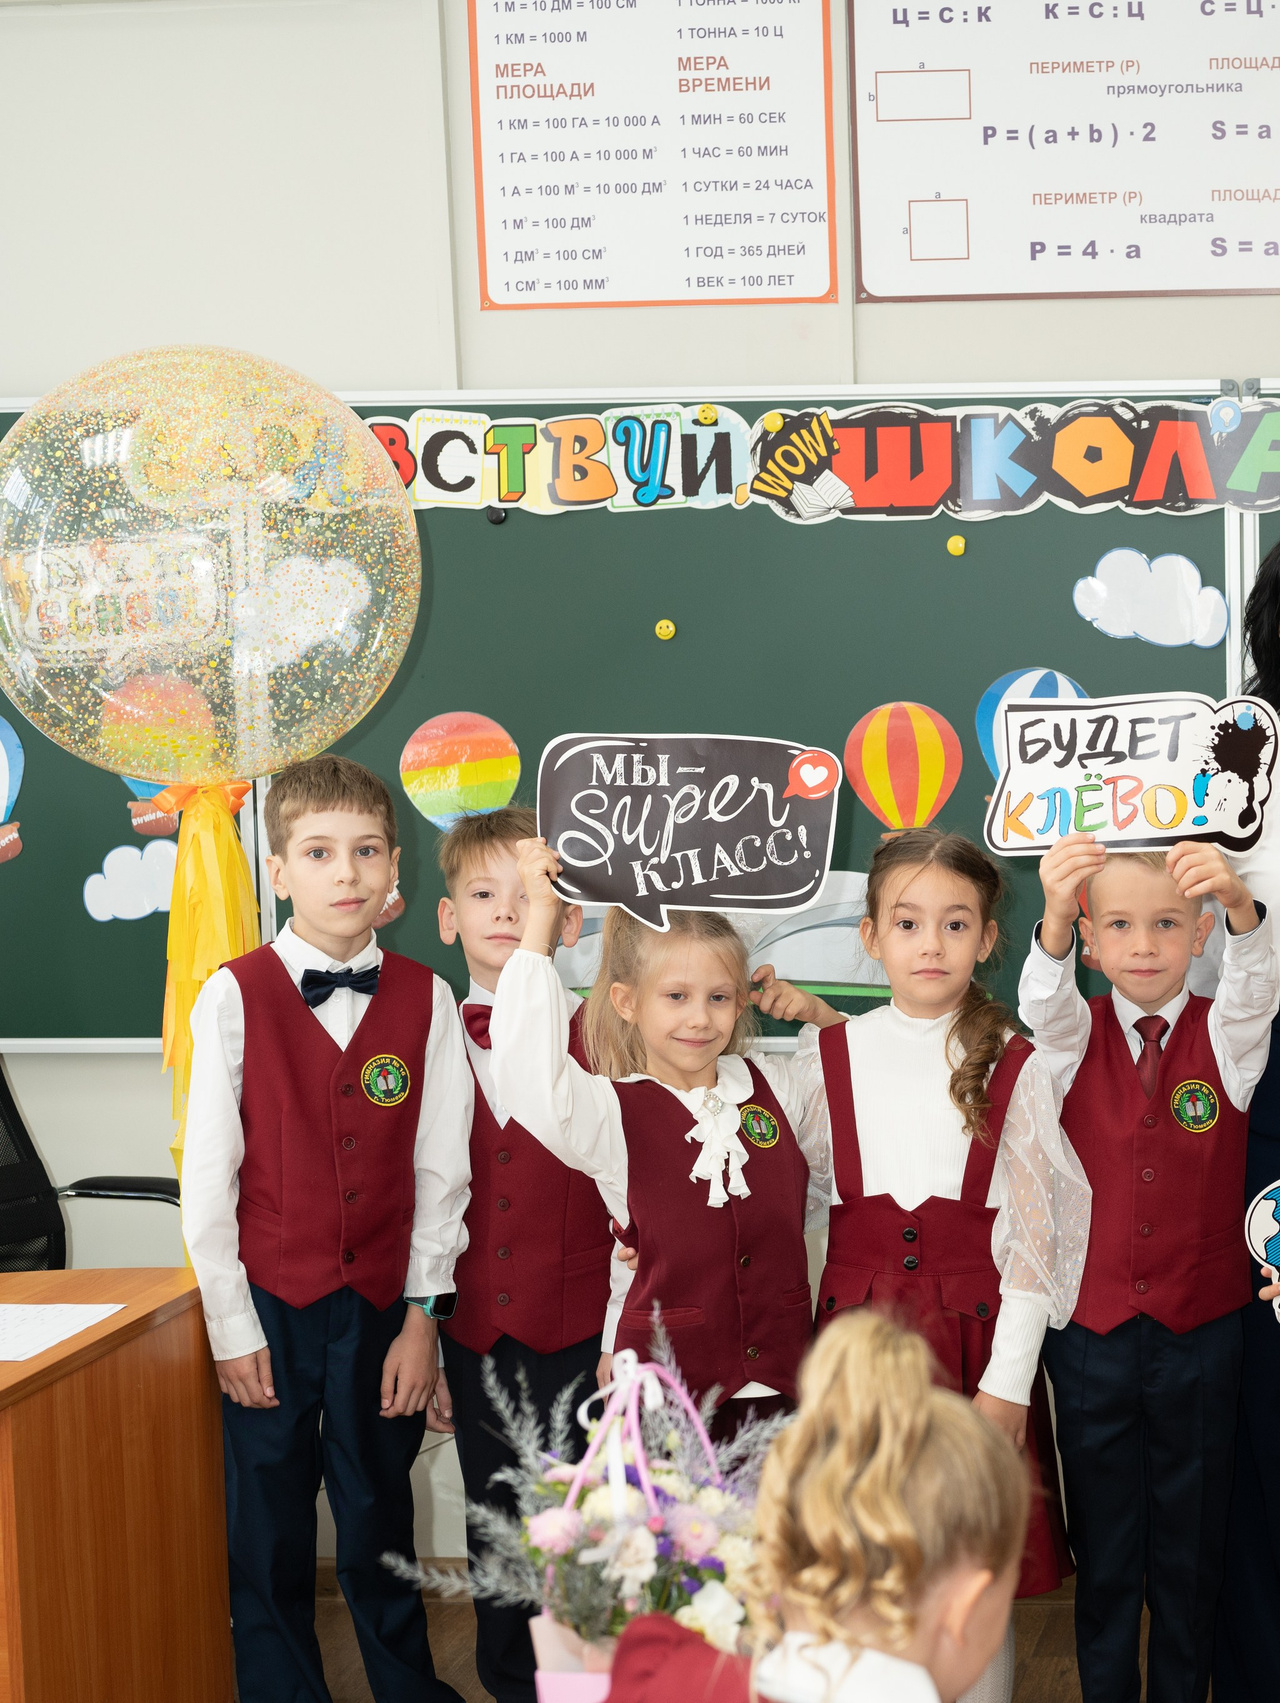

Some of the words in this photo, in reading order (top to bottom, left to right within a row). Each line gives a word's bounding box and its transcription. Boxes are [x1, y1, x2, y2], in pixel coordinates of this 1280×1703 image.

[505, 32, 525, 45] КМ
[541, 31, 572, 44] 1000
[576, 31, 588, 43] М
[687, 26, 738, 40] ТОННА
[754, 25, 769, 38] 10
[773, 25, 784, 39] Ц
[495, 62, 547, 79] МЕРА
[677, 55, 730, 72] МЕРА
[1029, 60, 1116, 75] ПЕРИМЕТР
[495, 82, 595, 101] ПЛОЩАДИ
[678, 75, 771, 94] ВРЕМЕНИ
[1106, 81, 1243, 98] прямоугольника
[508, 118, 528, 131] КМ
[544, 117, 568, 130] 100
[571, 116, 589, 129] ГА
[604, 115, 620, 128] 10
[623, 115, 647, 128] 000
[650, 114, 661, 127] А
[691, 113, 722, 126] МИН
[738, 112, 754, 125] 60
[758, 111, 786, 124] СЕК
[510, 151, 527, 164] ГА
[542, 150, 566, 163] 100
[569, 150, 580, 162] А
[595, 149, 611, 161] 10
[614, 148, 638, 161] 000
[692, 146, 722, 159] ЧАС
[737, 145, 753, 158] 60
[757, 144, 789, 157] МИН
[693, 179, 739, 193] СУТКИ
[754, 179, 771, 191] 24
[774, 178, 814, 191] ЧАСА
[1032, 191, 1118, 206] ПЕРИМЕТР
[694, 212, 753, 228] НЕДЕЛЯ
[780, 211, 827, 224] СУТОК
[1139, 211, 1215, 226] квадрата
[695, 245, 724, 260] ГОД
[739, 245, 763, 257] 365
[766, 241, 806, 259] ДНЕЙ
[696, 275, 724, 288] ВЕК
[740, 275, 763, 287] 100
[767, 274, 795, 287] ЛЕТ
[752, 410, 842, 502] WOW!
[1018, 712, 1197, 770] БУДЕТ
[1002, 772, 1213, 843] КЛЁВО!
[556, 774, 790, 876] Super
[629, 825, 812, 897] КЛАСС!
[364, 1058, 391, 1084] ГИМНАЗИЯ
[1174, 1084, 1200, 1108] ГИМНАЗИЯ
